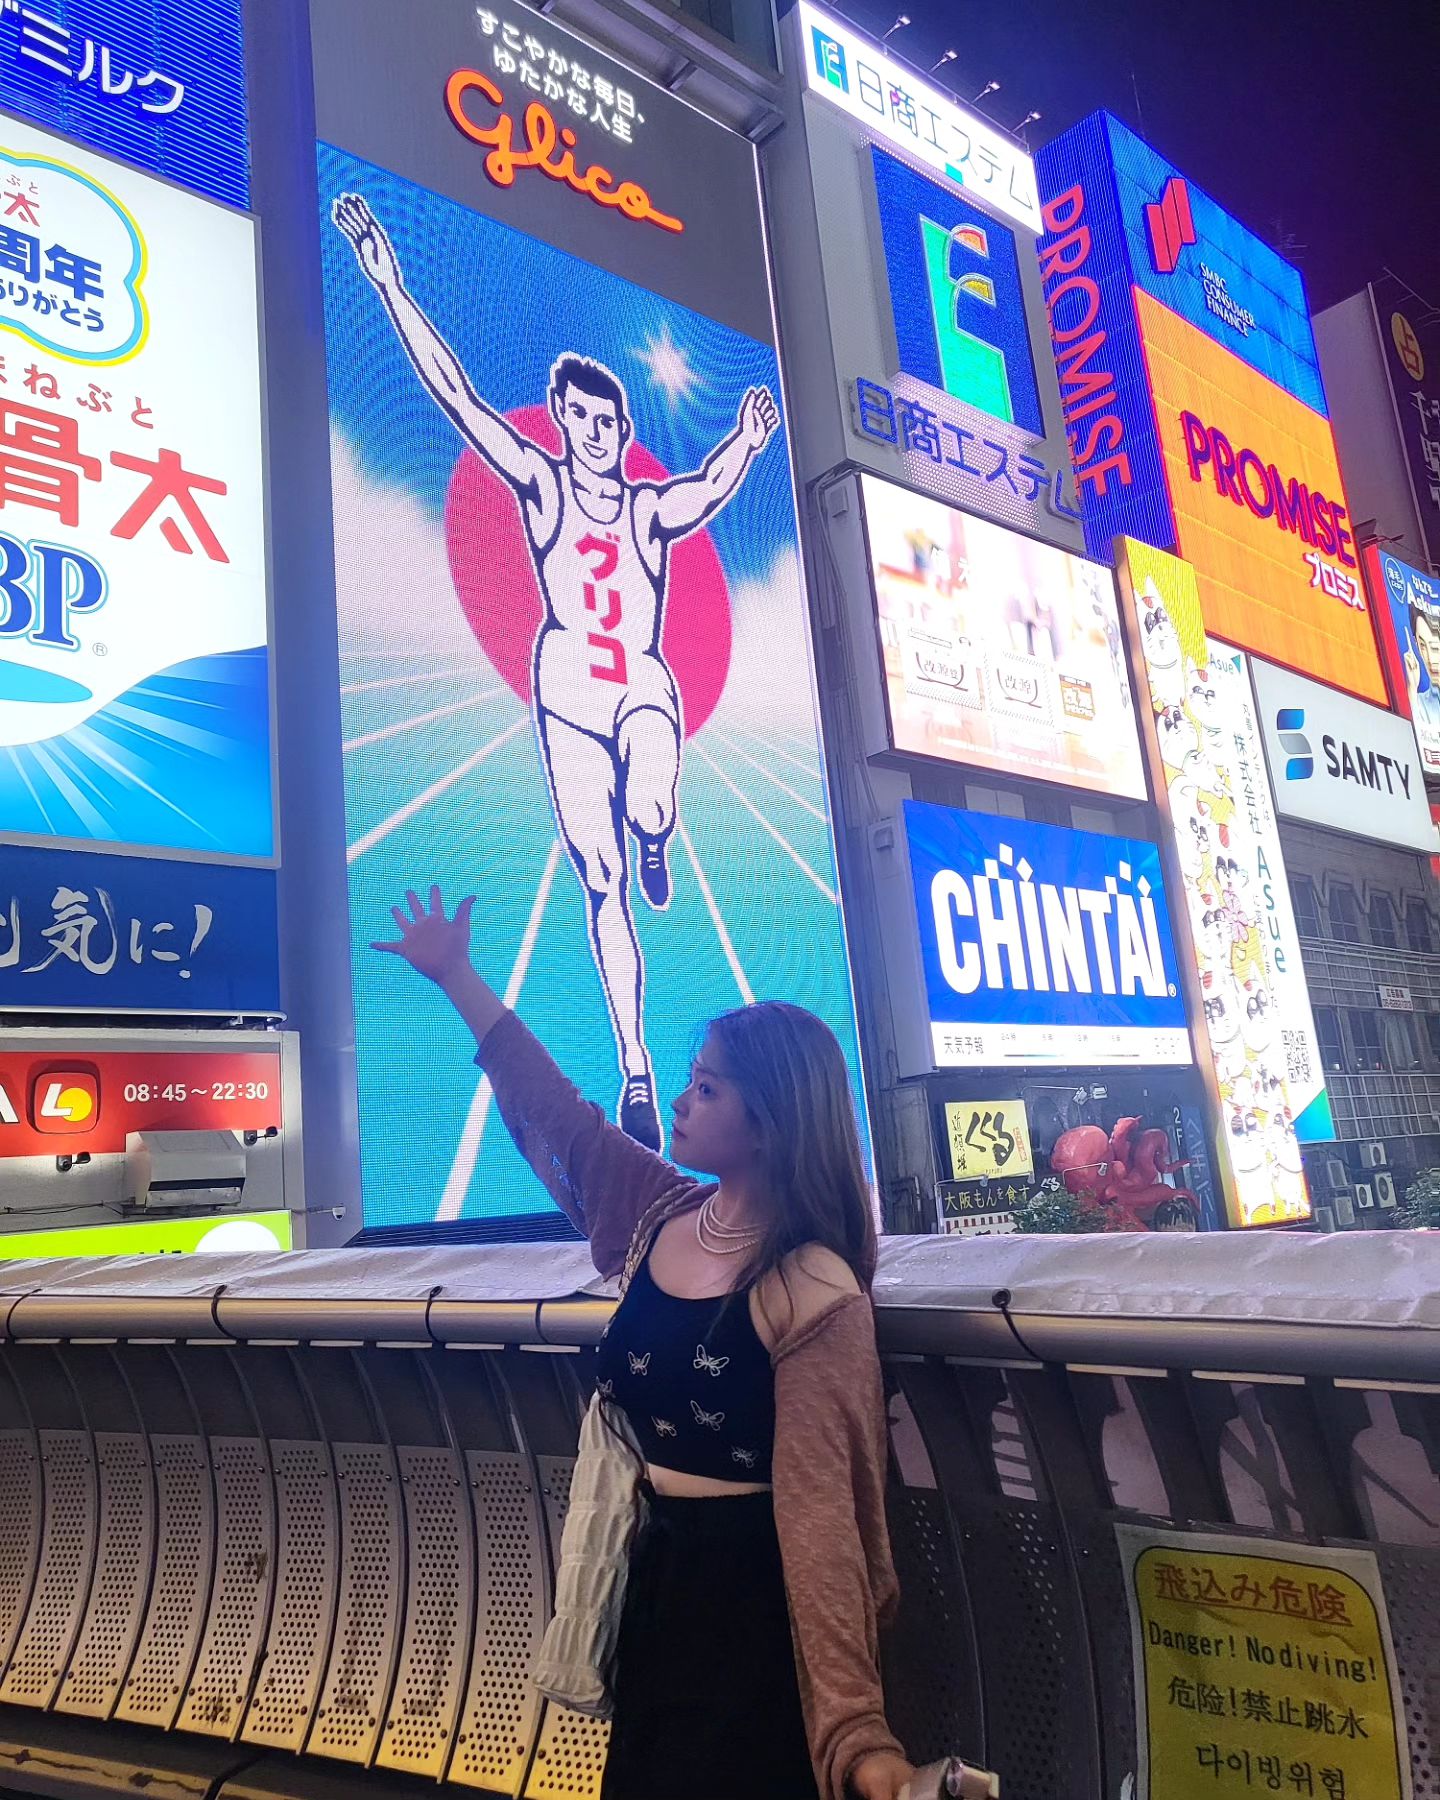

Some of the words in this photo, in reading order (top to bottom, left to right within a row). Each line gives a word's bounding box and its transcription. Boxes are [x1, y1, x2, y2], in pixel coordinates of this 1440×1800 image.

[476, 6, 645, 124] すこやかな毎日、
[493, 44, 632, 144] ゆたかな人生
[446, 68, 684, 232] Glico
[856, 60, 1033, 211] 日商エステム
[1200, 261, 1228, 293] SMBC
[1203, 279, 1257, 330] CONSUMER
[1040, 184, 1133, 498] PROMISE
[1206, 294, 1249, 338] FINANCE
[1180, 409, 1356, 569] PROMISE
[574, 532, 628, 686] グリコ
[1303, 552, 1365, 611] プロミス
[1209, 653, 1234, 675] Asue
[1322, 734, 1411, 800] SAMTY
[930, 843, 1169, 997] CHINTAI
[1256, 845, 1287, 973] Asue
[965, 1111, 1015, 1167] くくる
[944, 1184, 1030, 1212] 大阪もんを食す
[1153, 1561, 1351, 1622] 飛込み危険
[1149, 1620, 1235, 1656] Danger!
